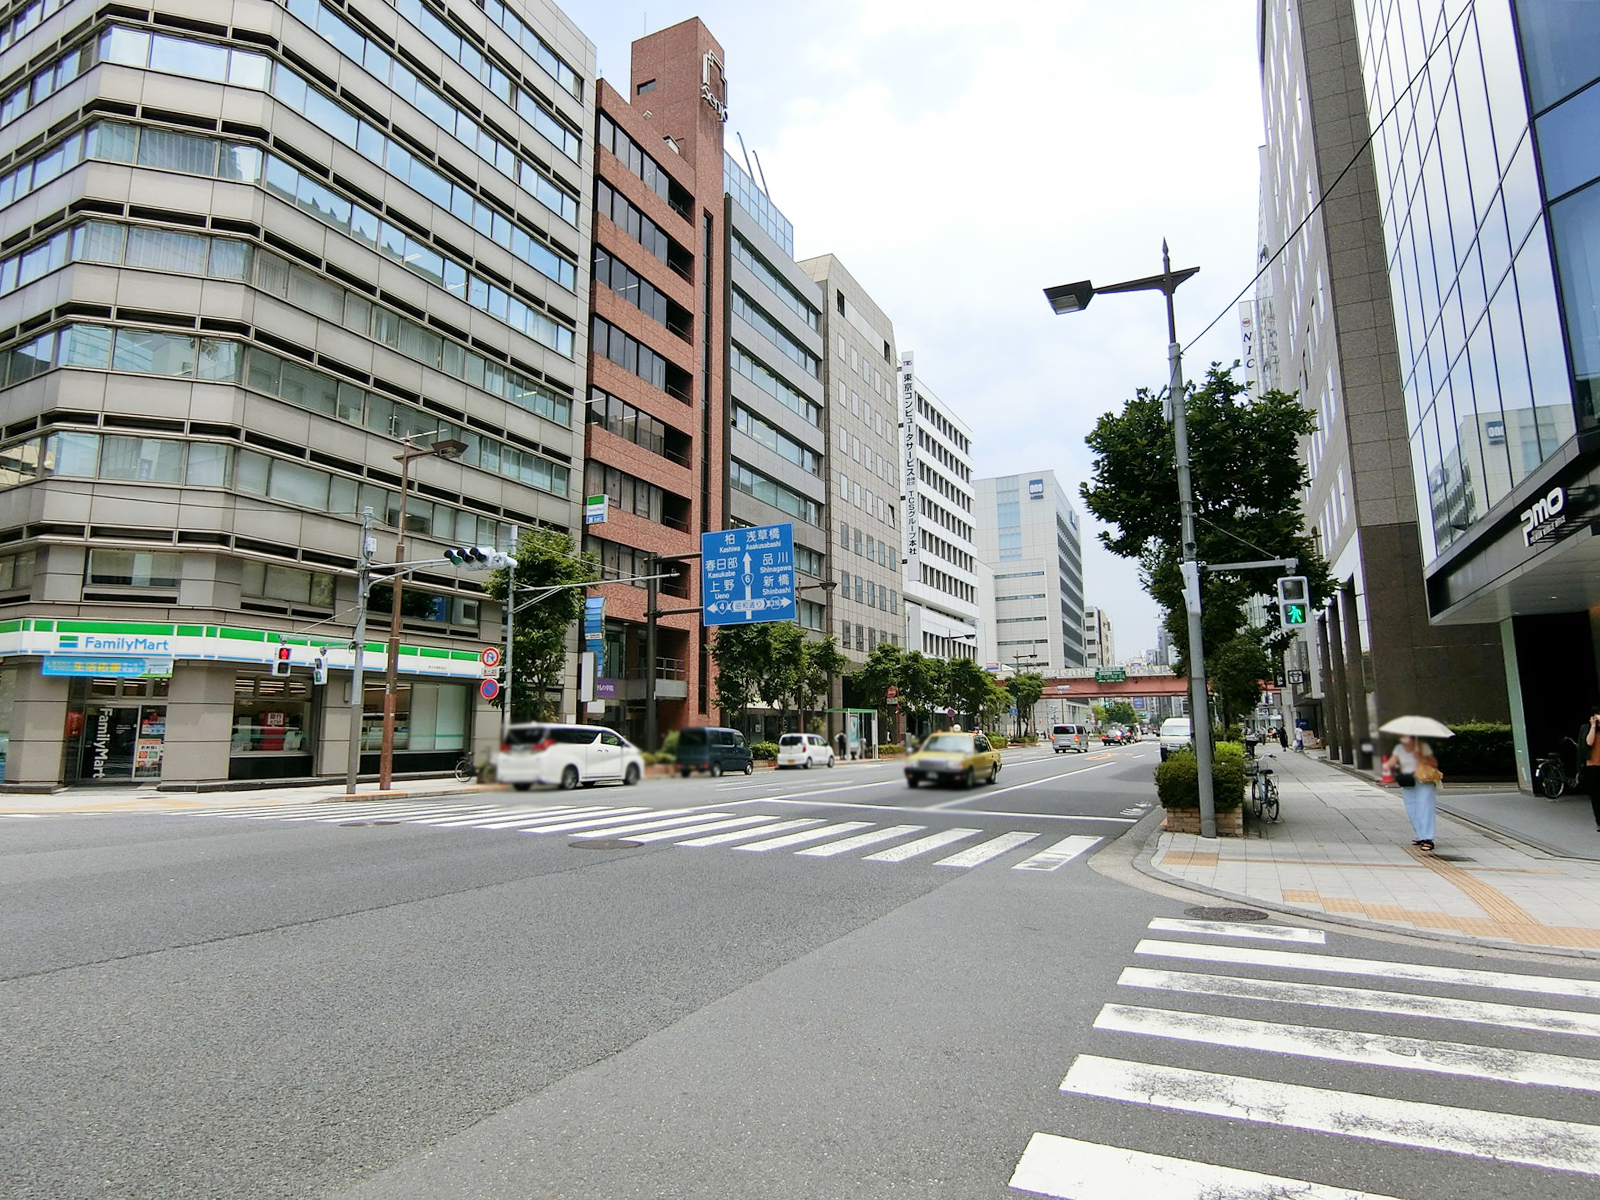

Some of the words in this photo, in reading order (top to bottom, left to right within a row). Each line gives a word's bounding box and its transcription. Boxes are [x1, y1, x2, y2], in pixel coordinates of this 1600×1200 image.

[725, 534, 736, 545] 柏
[746, 528, 780, 543] 浅草橋
[720, 545, 741, 553] Kashiwa
[745, 540, 781, 551] Asakusabashi
[705, 557, 738, 572] 春日部
[763, 552, 788, 566] 品川
[707, 571, 736, 579] Kasukabe
[760, 565, 792, 574] Shinagawa
[710, 579, 735, 593] 上野
[763, 574, 790, 587] 新橋
[762, 587, 791, 596] Shinbashi
[85, 636, 169, 651] FamilyMart
[92, 708, 113, 779] FamilyMart
